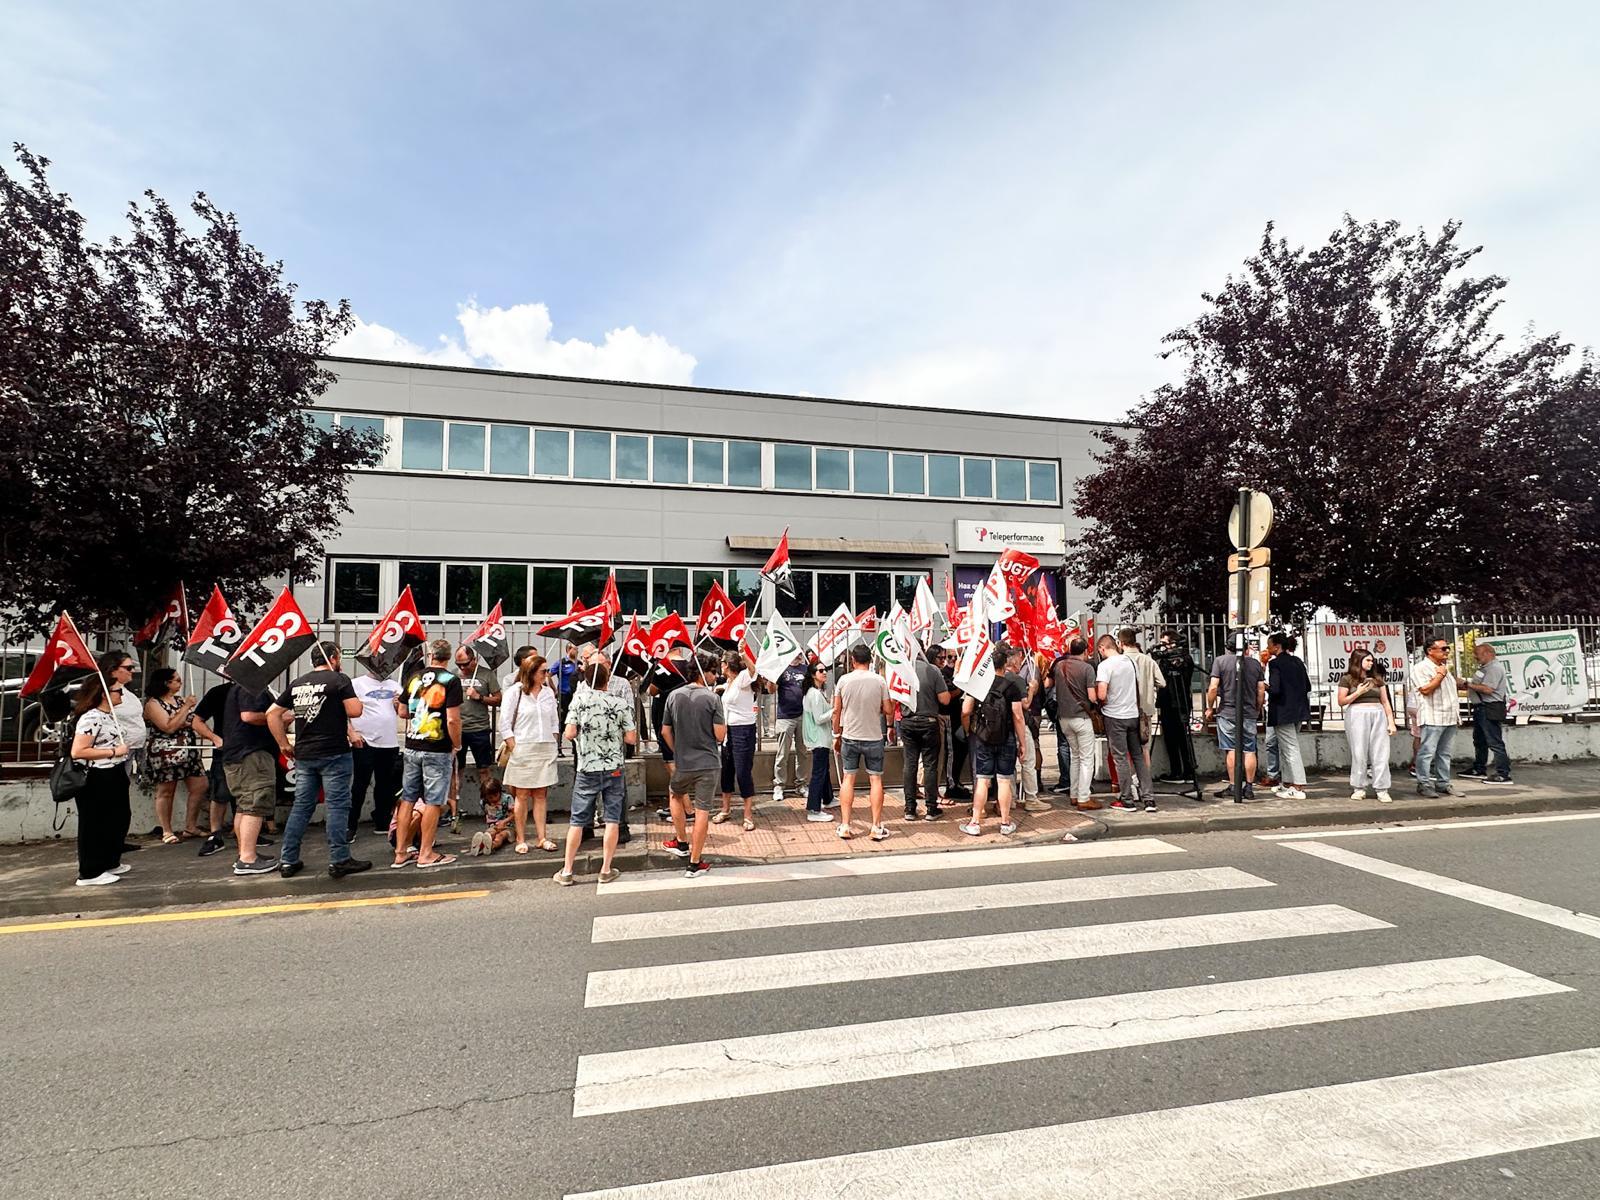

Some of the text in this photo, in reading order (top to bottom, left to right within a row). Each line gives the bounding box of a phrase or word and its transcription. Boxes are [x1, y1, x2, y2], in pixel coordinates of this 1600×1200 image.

[989, 531, 1044, 543] Teleperformance
[1001, 559, 1031, 577] UGT
[1325, 625, 1400, 636] NO AL ERE SALVAJE
[1344, 640, 1370, 653] UGT
[1329, 658, 1345, 669] LOS
[1391, 657, 1403, 668] NO
[1561, 667, 1580, 685] ERE
[1517, 702, 1570, 712] Teleperformance
